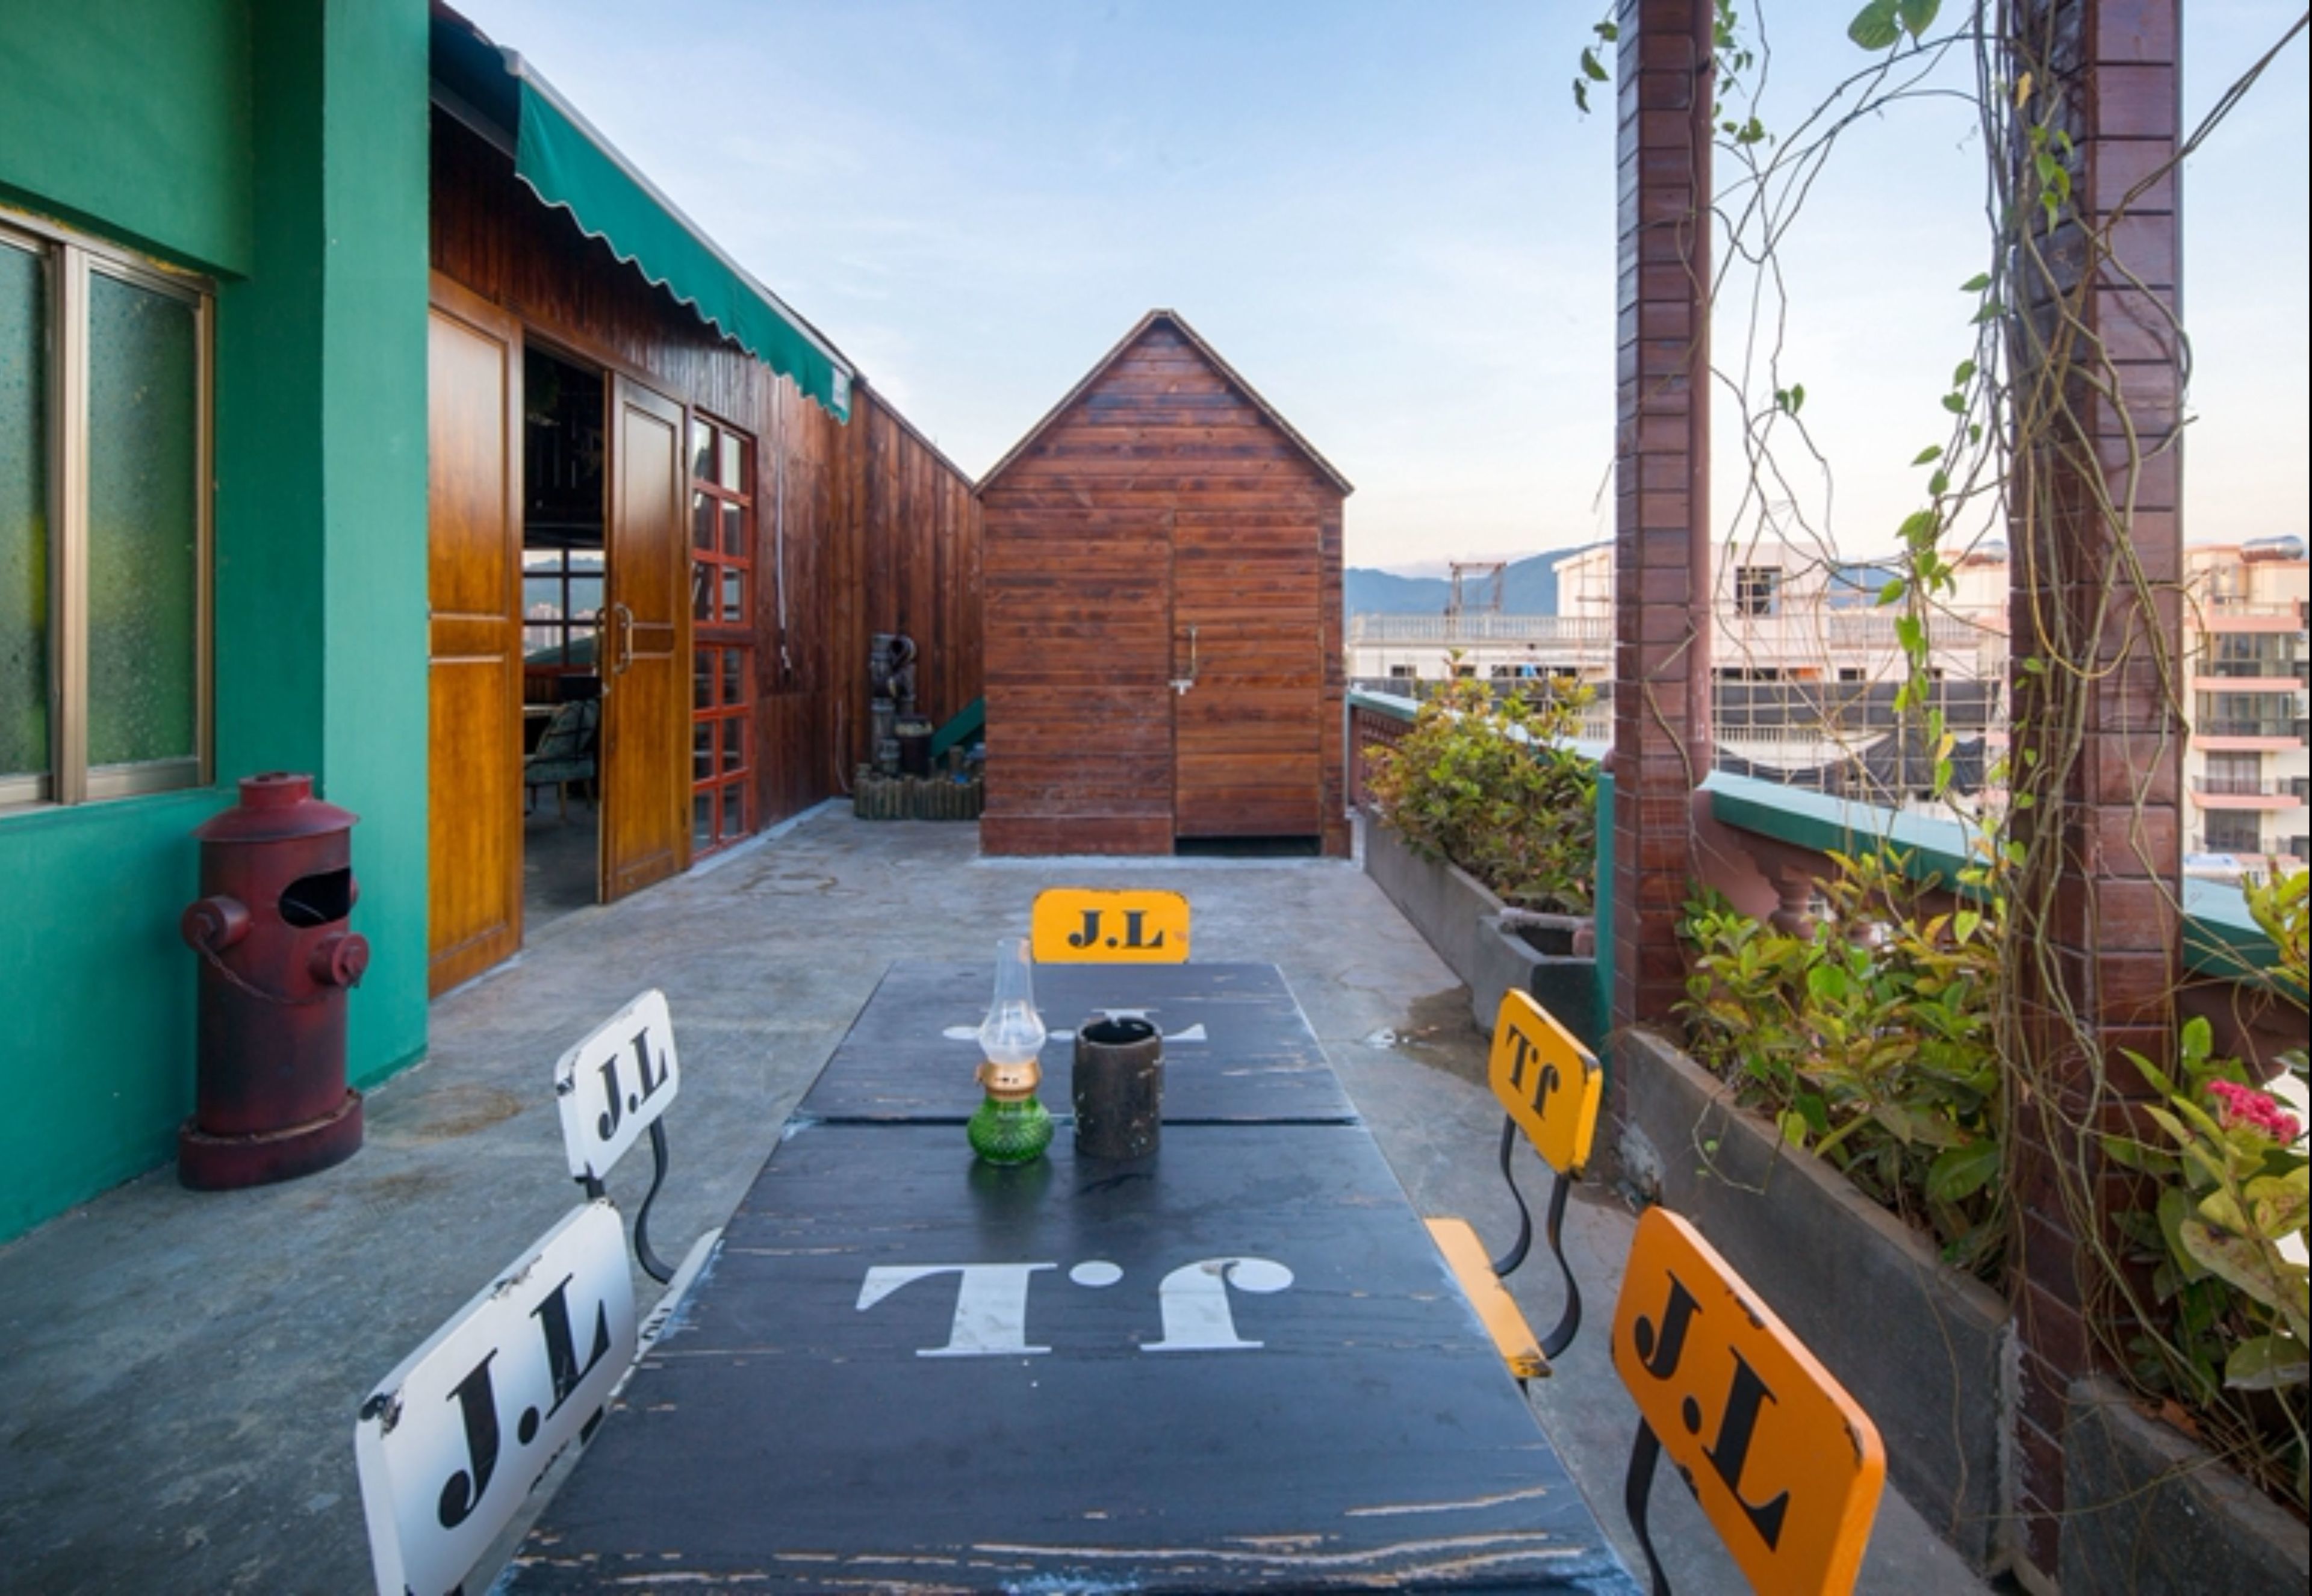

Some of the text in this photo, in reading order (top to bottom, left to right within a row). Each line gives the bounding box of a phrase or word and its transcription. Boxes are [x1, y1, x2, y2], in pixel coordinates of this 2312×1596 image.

[1068, 910, 1163, 948] J.L
[598, 1026, 668, 1141] J.L
[438, 1273, 611, 1529] J.L
[1634, 1270, 1789, 1553] J.L
